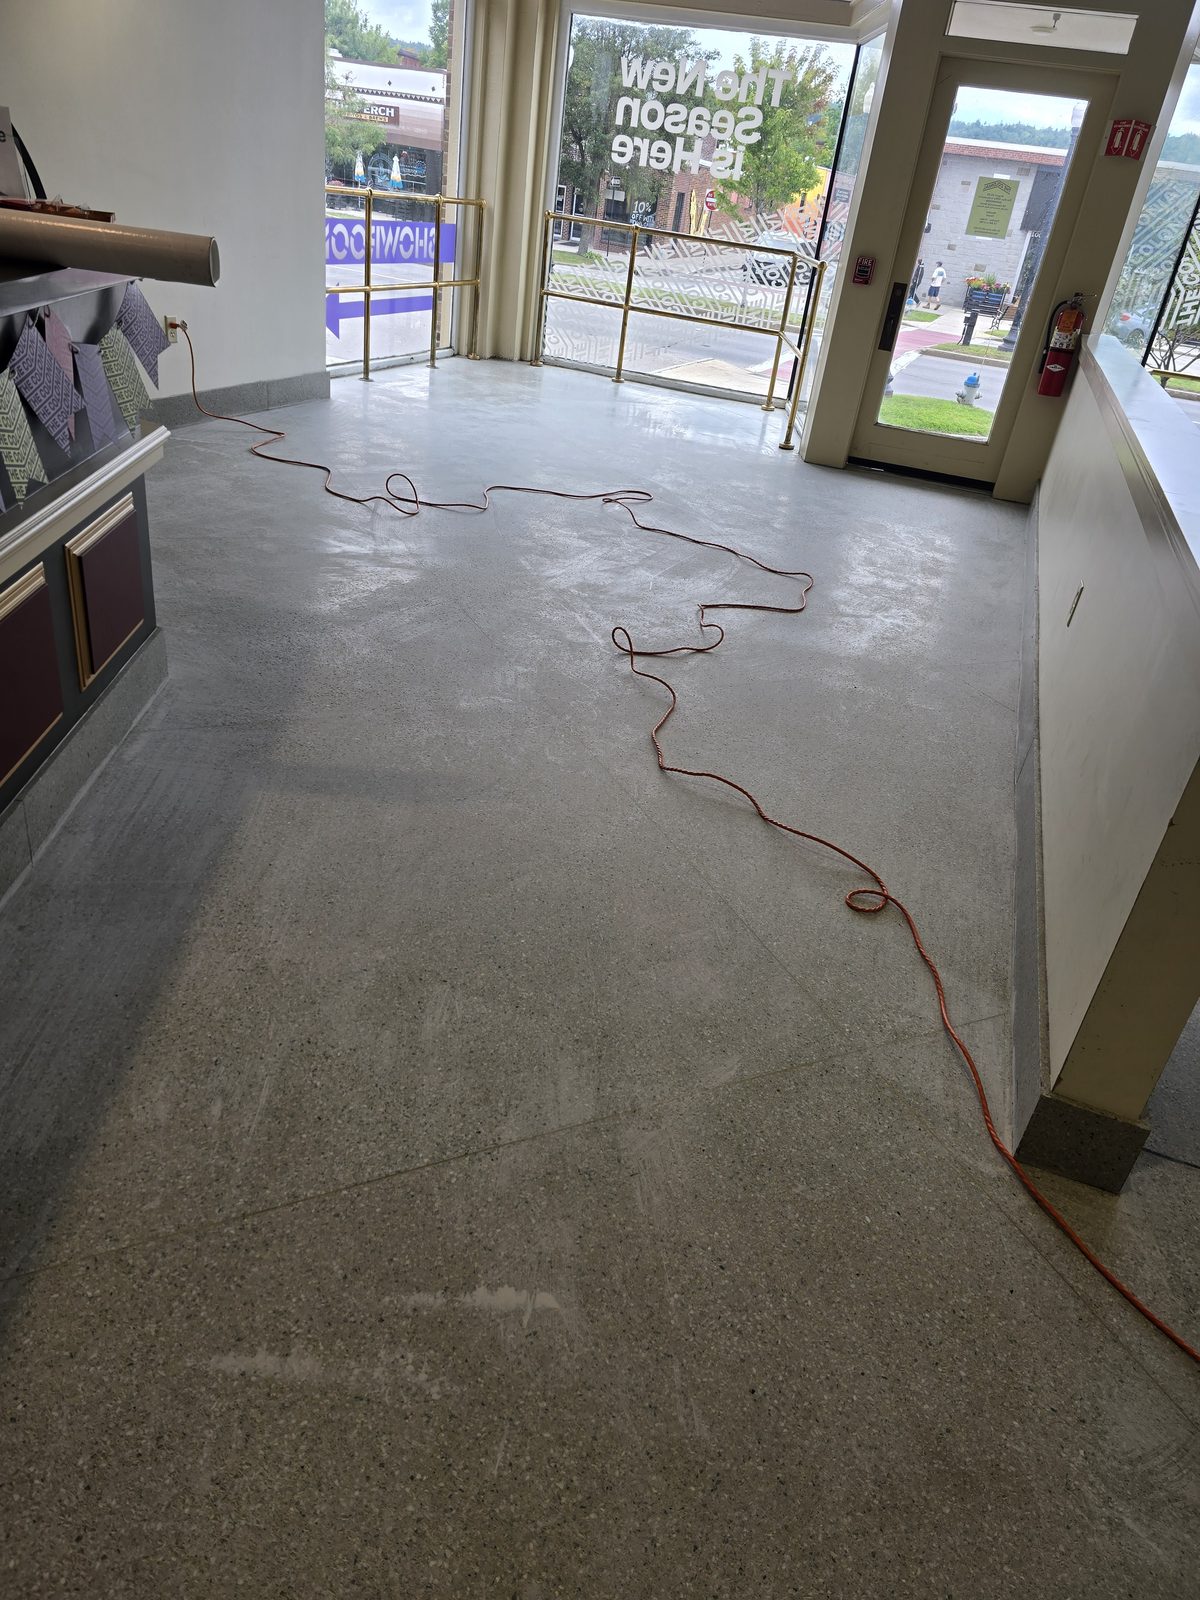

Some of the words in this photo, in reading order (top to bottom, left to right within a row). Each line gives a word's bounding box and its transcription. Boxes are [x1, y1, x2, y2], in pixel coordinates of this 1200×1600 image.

[363, 105, 395, 118] ERCH
[632, 200, 652, 213] 10%
[857, 257, 872, 266] FIRE
